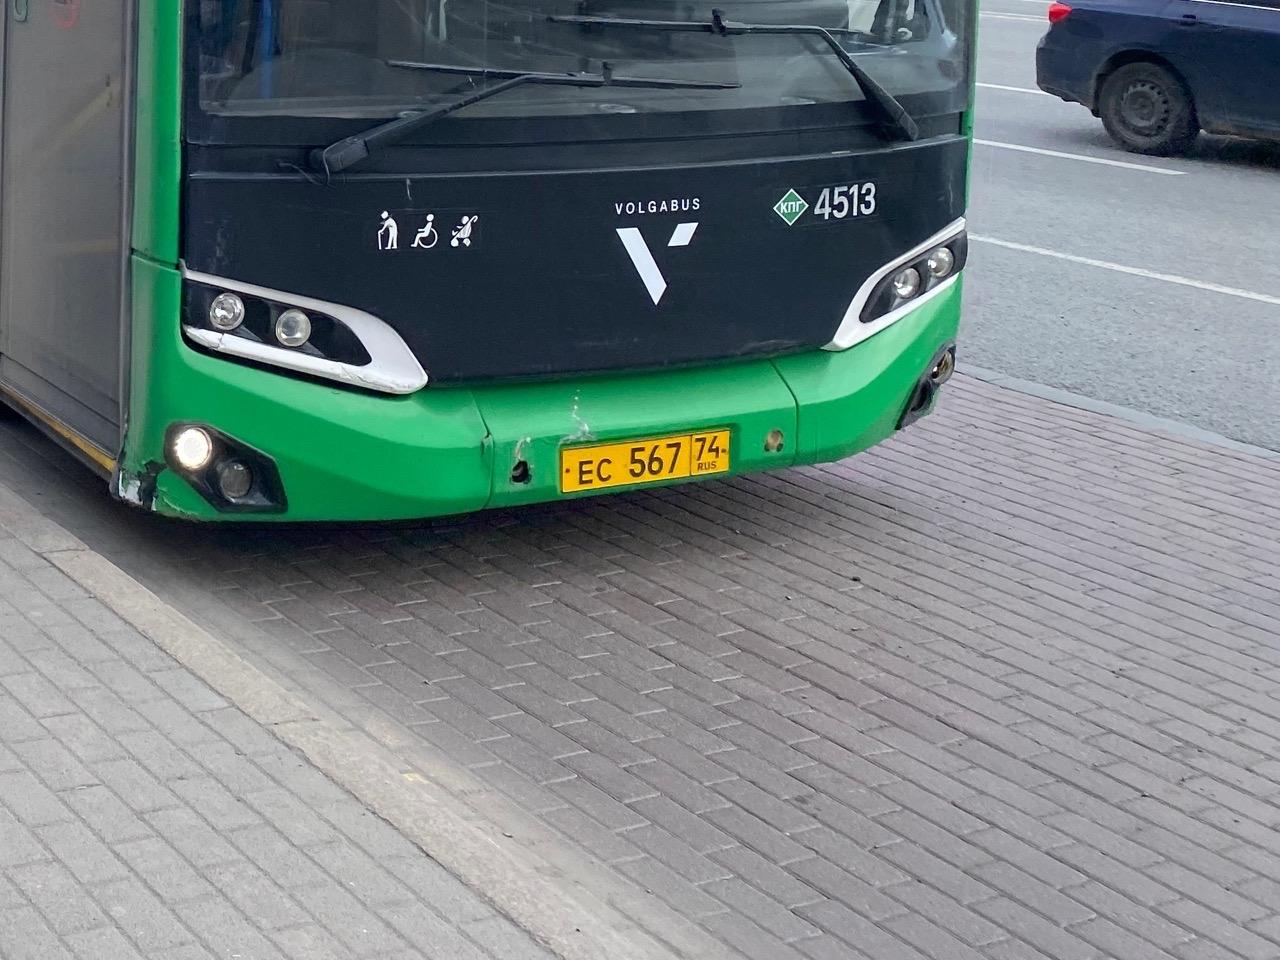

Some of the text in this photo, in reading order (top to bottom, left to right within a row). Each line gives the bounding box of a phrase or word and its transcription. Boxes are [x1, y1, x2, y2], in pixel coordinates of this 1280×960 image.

[615, 198, 701, 215] VOLGABUS
[780, 201, 803, 214] КПГ
[814, 182, 876, 220] 4513
[628, 442, 682, 478] 567
[694, 436, 720, 461] 74
[697, 461, 717, 471] RUS
